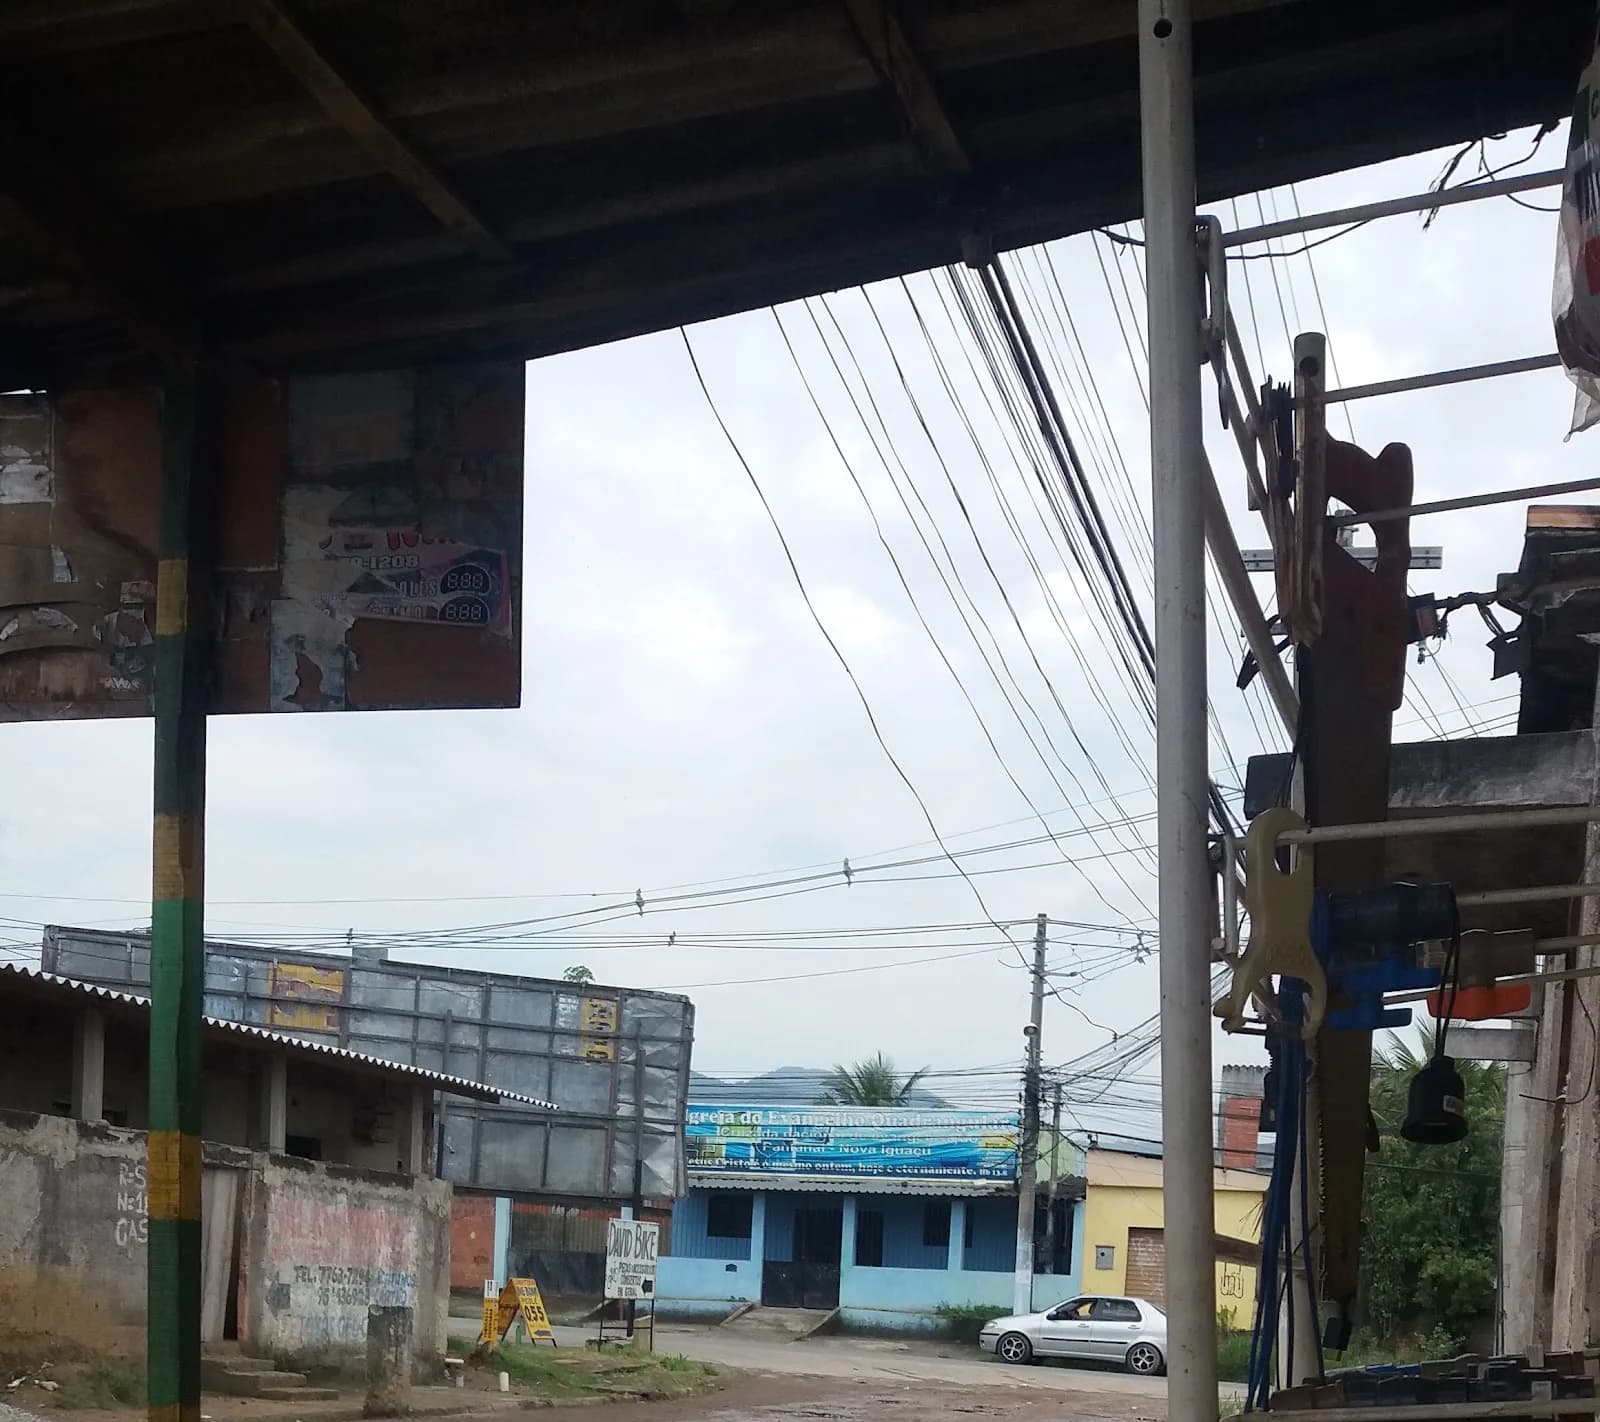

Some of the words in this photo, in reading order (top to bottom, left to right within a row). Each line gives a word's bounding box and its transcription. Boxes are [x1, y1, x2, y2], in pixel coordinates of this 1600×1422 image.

[685, 1109, 735, 1125] Igreja
[740, 1111, 763, 1124] do
[768, 1111, 865, 1130] Evangelho
[871, 1113, 1009, 1132] Quadrangular
[839, 1143, 877, 1154] Nova
[716, 1158, 750, 1168] Cristo
[858, 1163, 884, 1174] hoje
[608, 1222, 633, 1258] DAVID
[634, 1223, 657, 1261] BIKE
